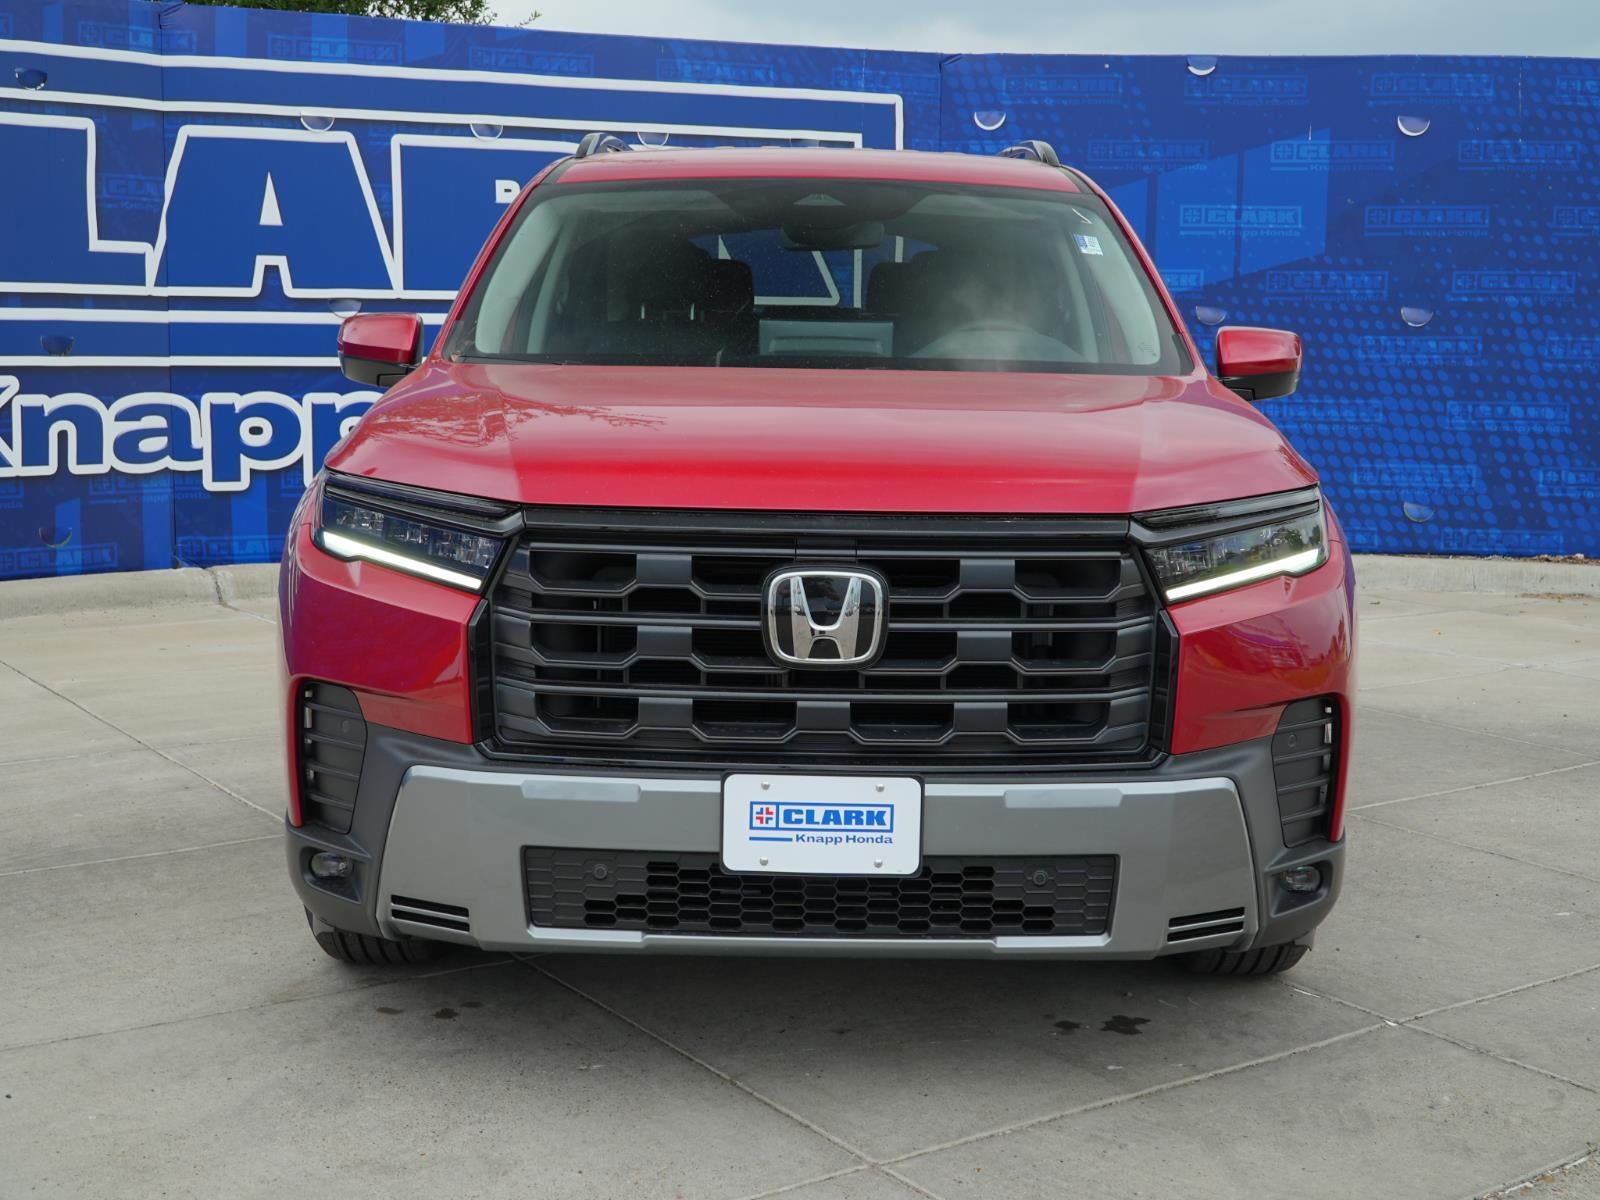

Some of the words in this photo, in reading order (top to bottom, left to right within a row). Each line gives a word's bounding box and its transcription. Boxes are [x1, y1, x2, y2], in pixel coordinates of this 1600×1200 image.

[1207, 209, 1296, 224] CLARK
[1218, 228, 1258, 239] Knpp
[0, 376, 388, 491] napp
[783, 808, 886, 826] CLARK
[795, 834, 843, 846] Knapp
[846, 835, 893, 845] Honda
